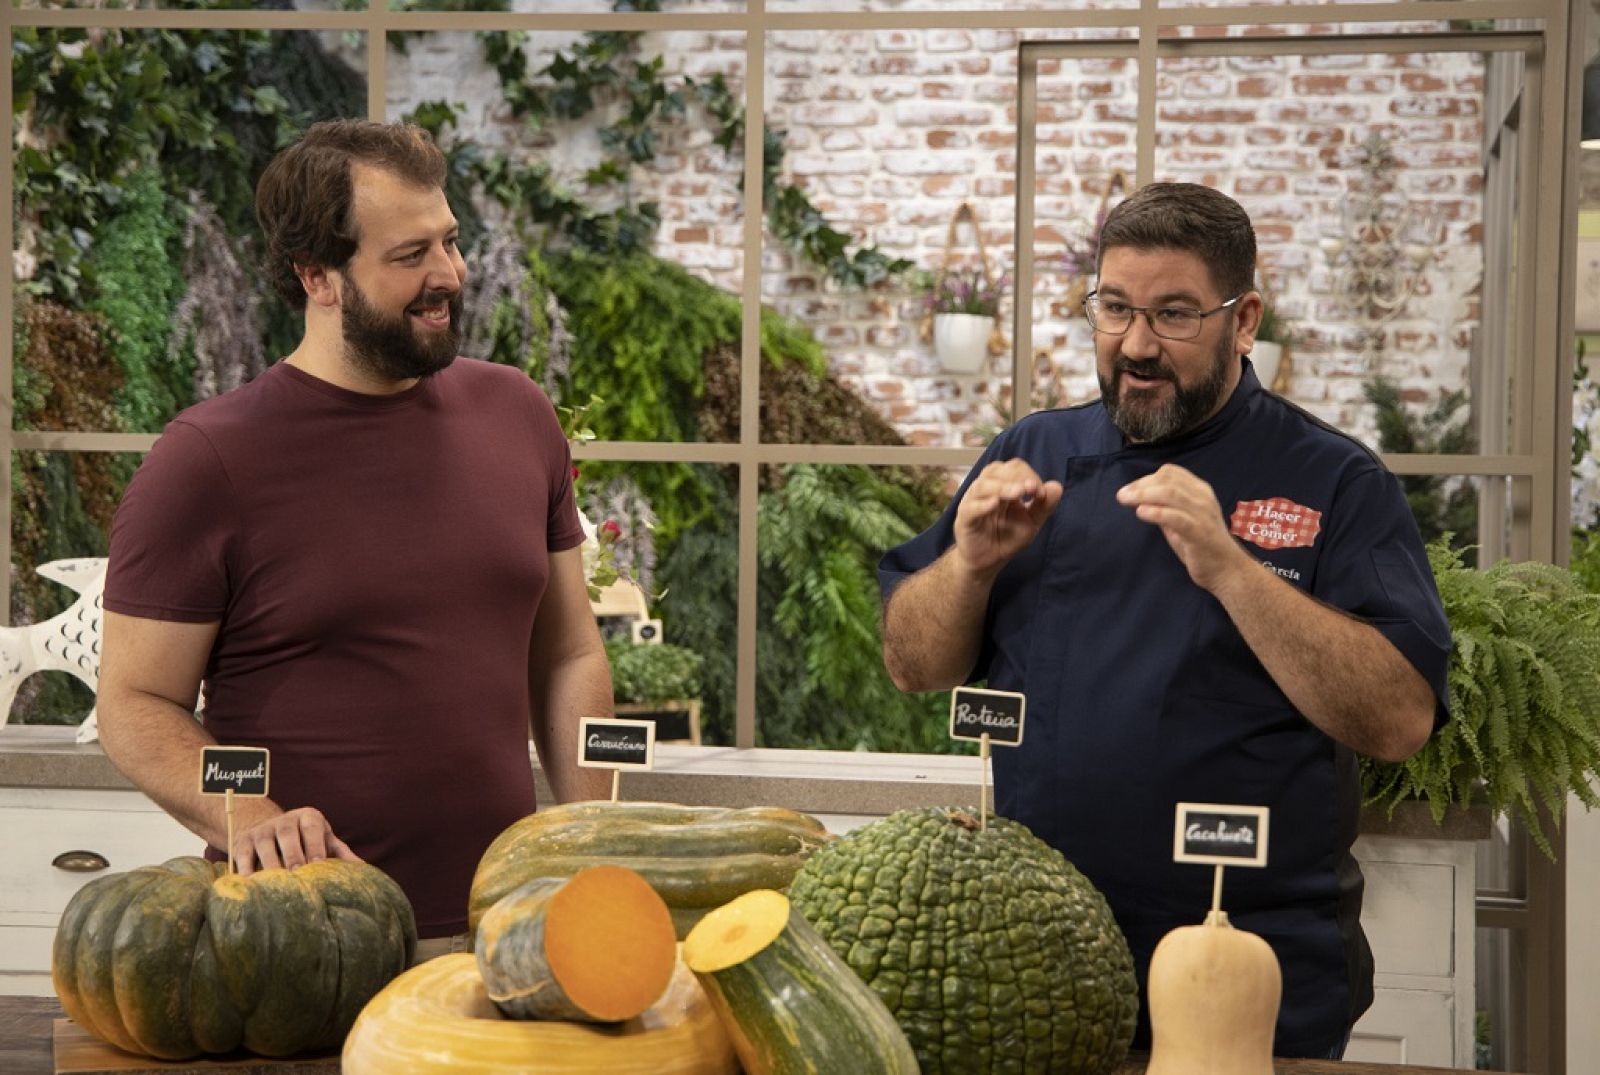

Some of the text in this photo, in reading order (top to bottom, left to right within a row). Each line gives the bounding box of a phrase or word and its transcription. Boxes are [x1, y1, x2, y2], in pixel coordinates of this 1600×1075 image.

[1256, 505, 1301, 522] Hacer
[1249, 523, 1297, 541] Comer
[205, 762, 264, 786] Musquet
